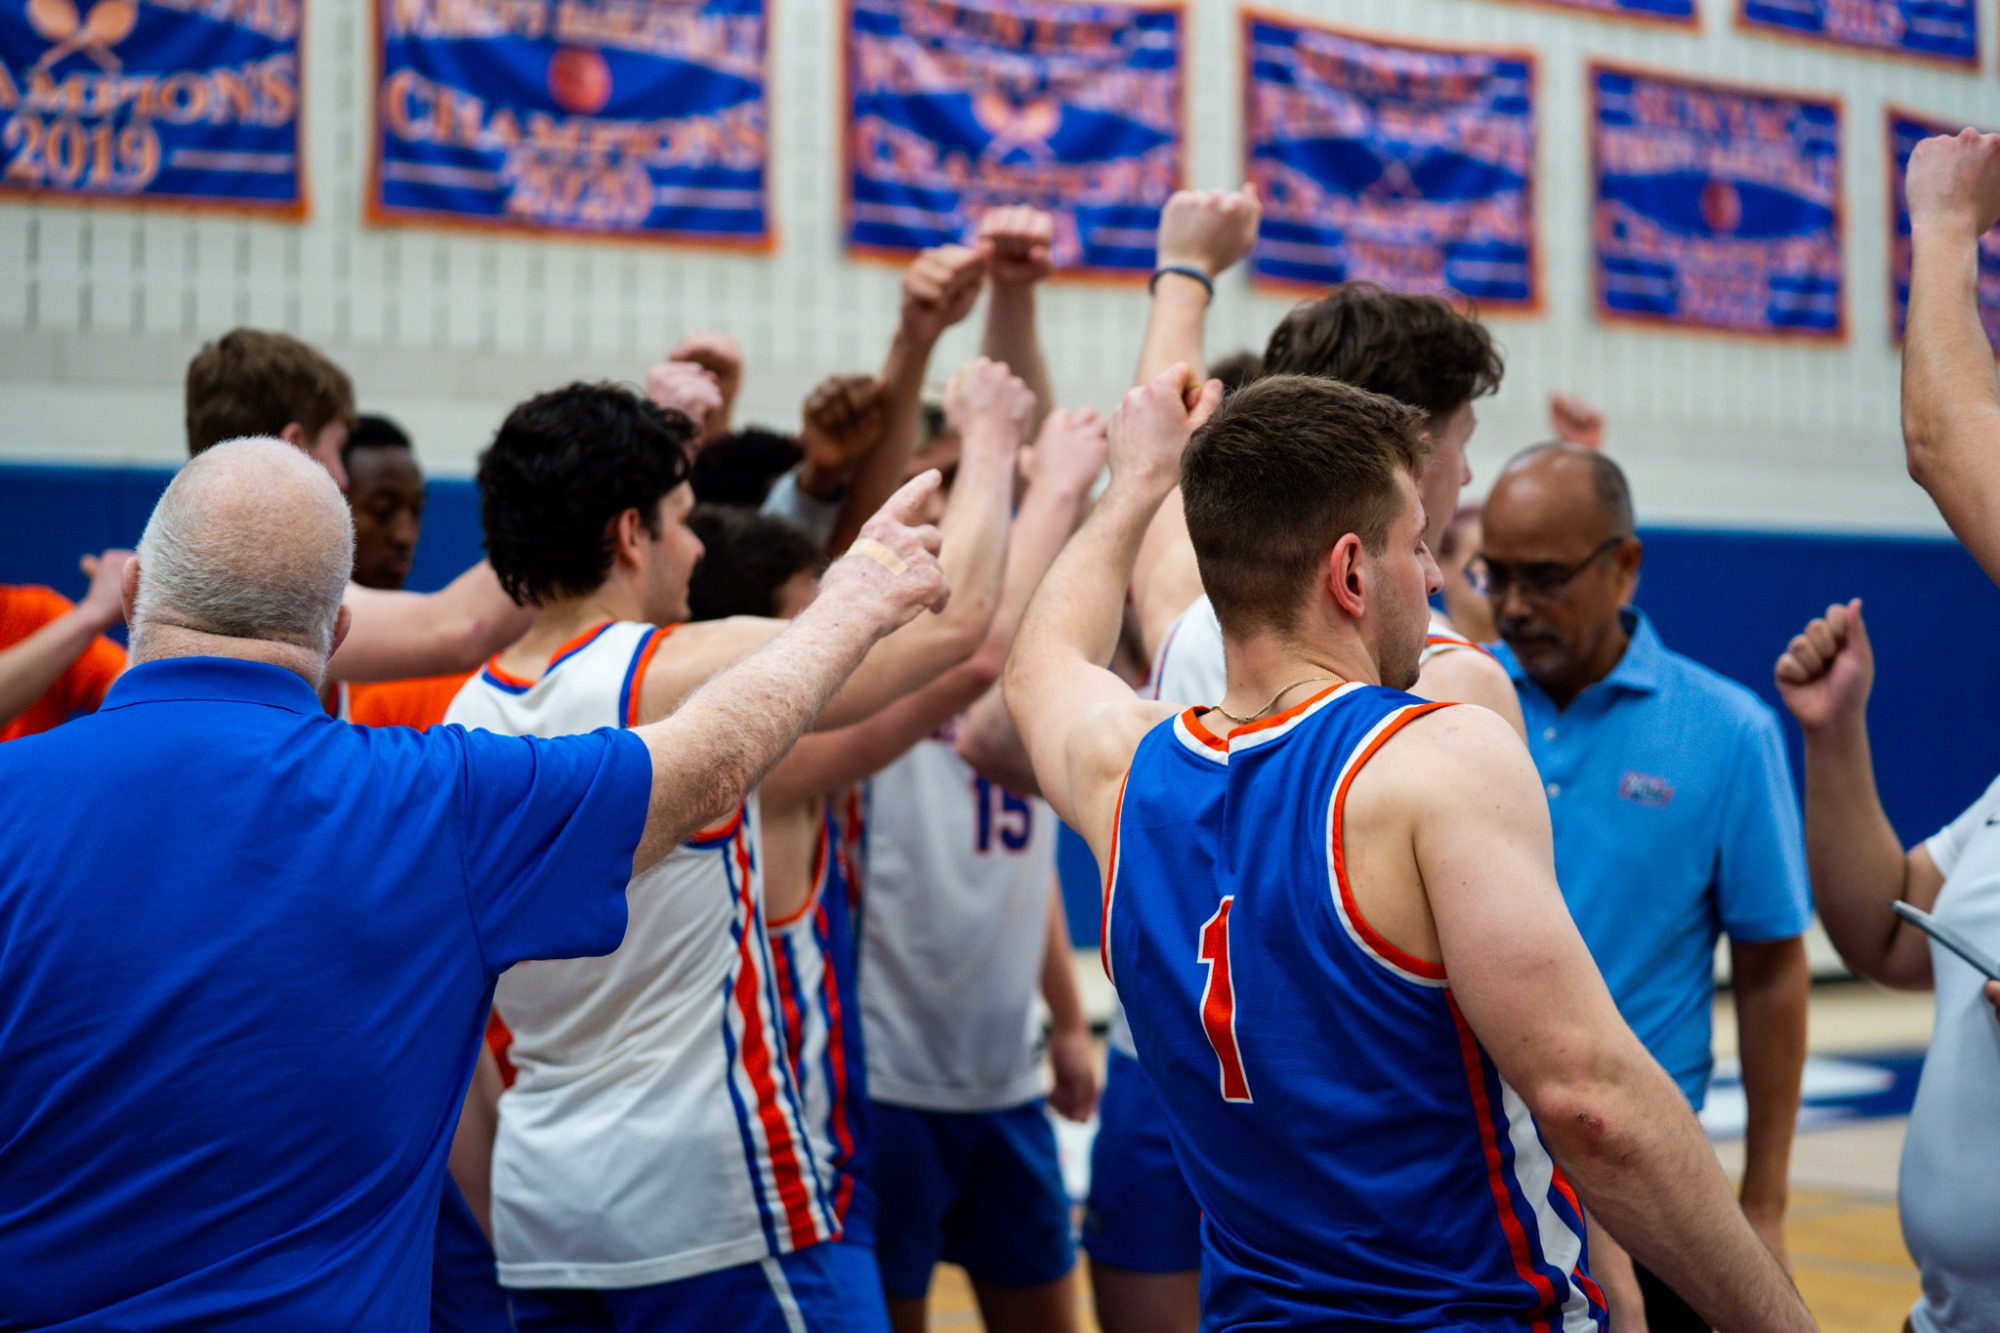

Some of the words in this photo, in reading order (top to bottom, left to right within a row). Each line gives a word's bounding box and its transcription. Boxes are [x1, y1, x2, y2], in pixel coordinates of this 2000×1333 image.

[2, 113, 161, 190] 2019
[385, 67, 767, 171] CHAMPIONS
[973, 776, 1033, 854] 15
[1197, 895, 1254, 1104] 1
